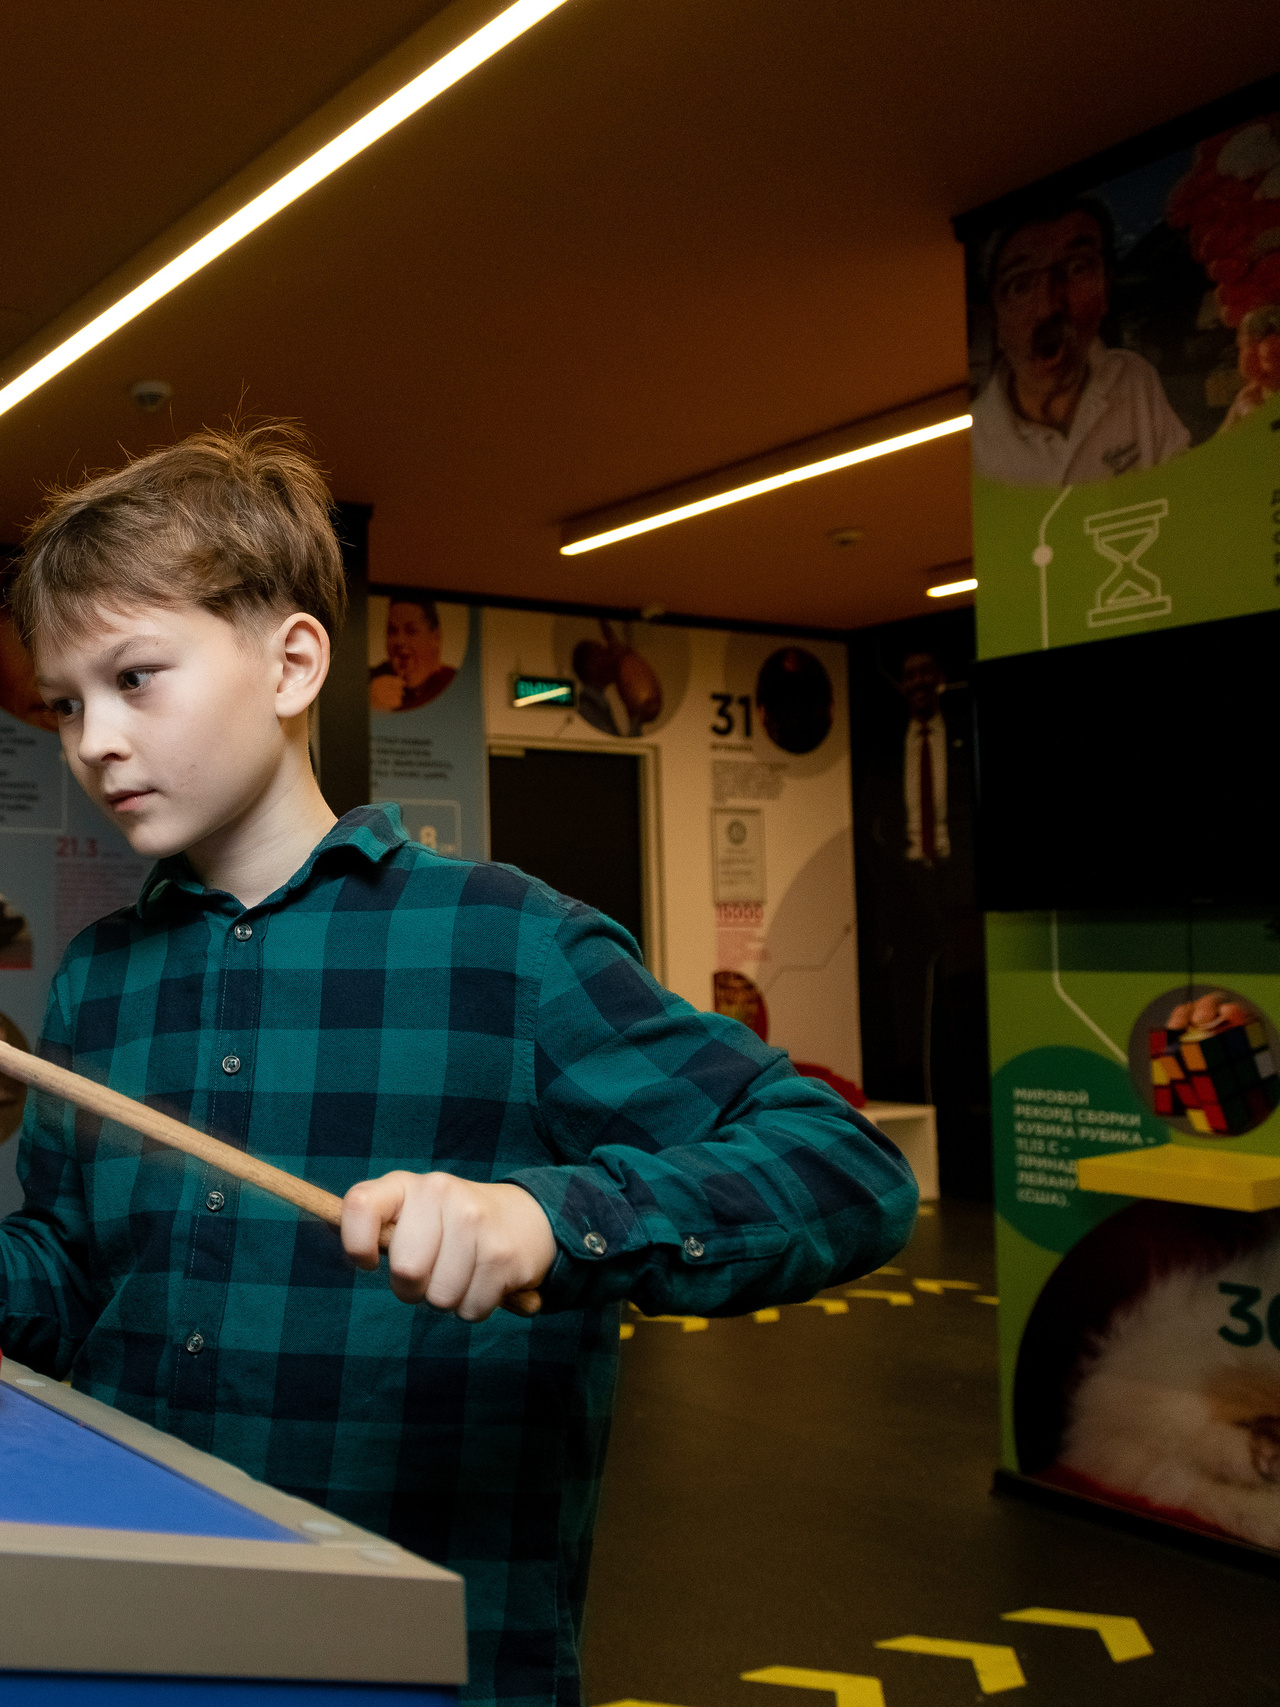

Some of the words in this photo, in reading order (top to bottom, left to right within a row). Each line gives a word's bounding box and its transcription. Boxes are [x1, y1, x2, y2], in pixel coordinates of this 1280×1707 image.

[710, 693, 752, 737] 31
[1013, 1086, 1089, 1106] МИРОВОЙ
[1013, 1104, 1074, 1123] РЕКОРД
[1075, 1109, 1141, 1127] СБОРКИ
[1014, 1121, 1076, 1139] КУБИКА
[1078, 1126, 1144, 1146] РУБИКА
[1218, 1279, 1280, 1352] 3
